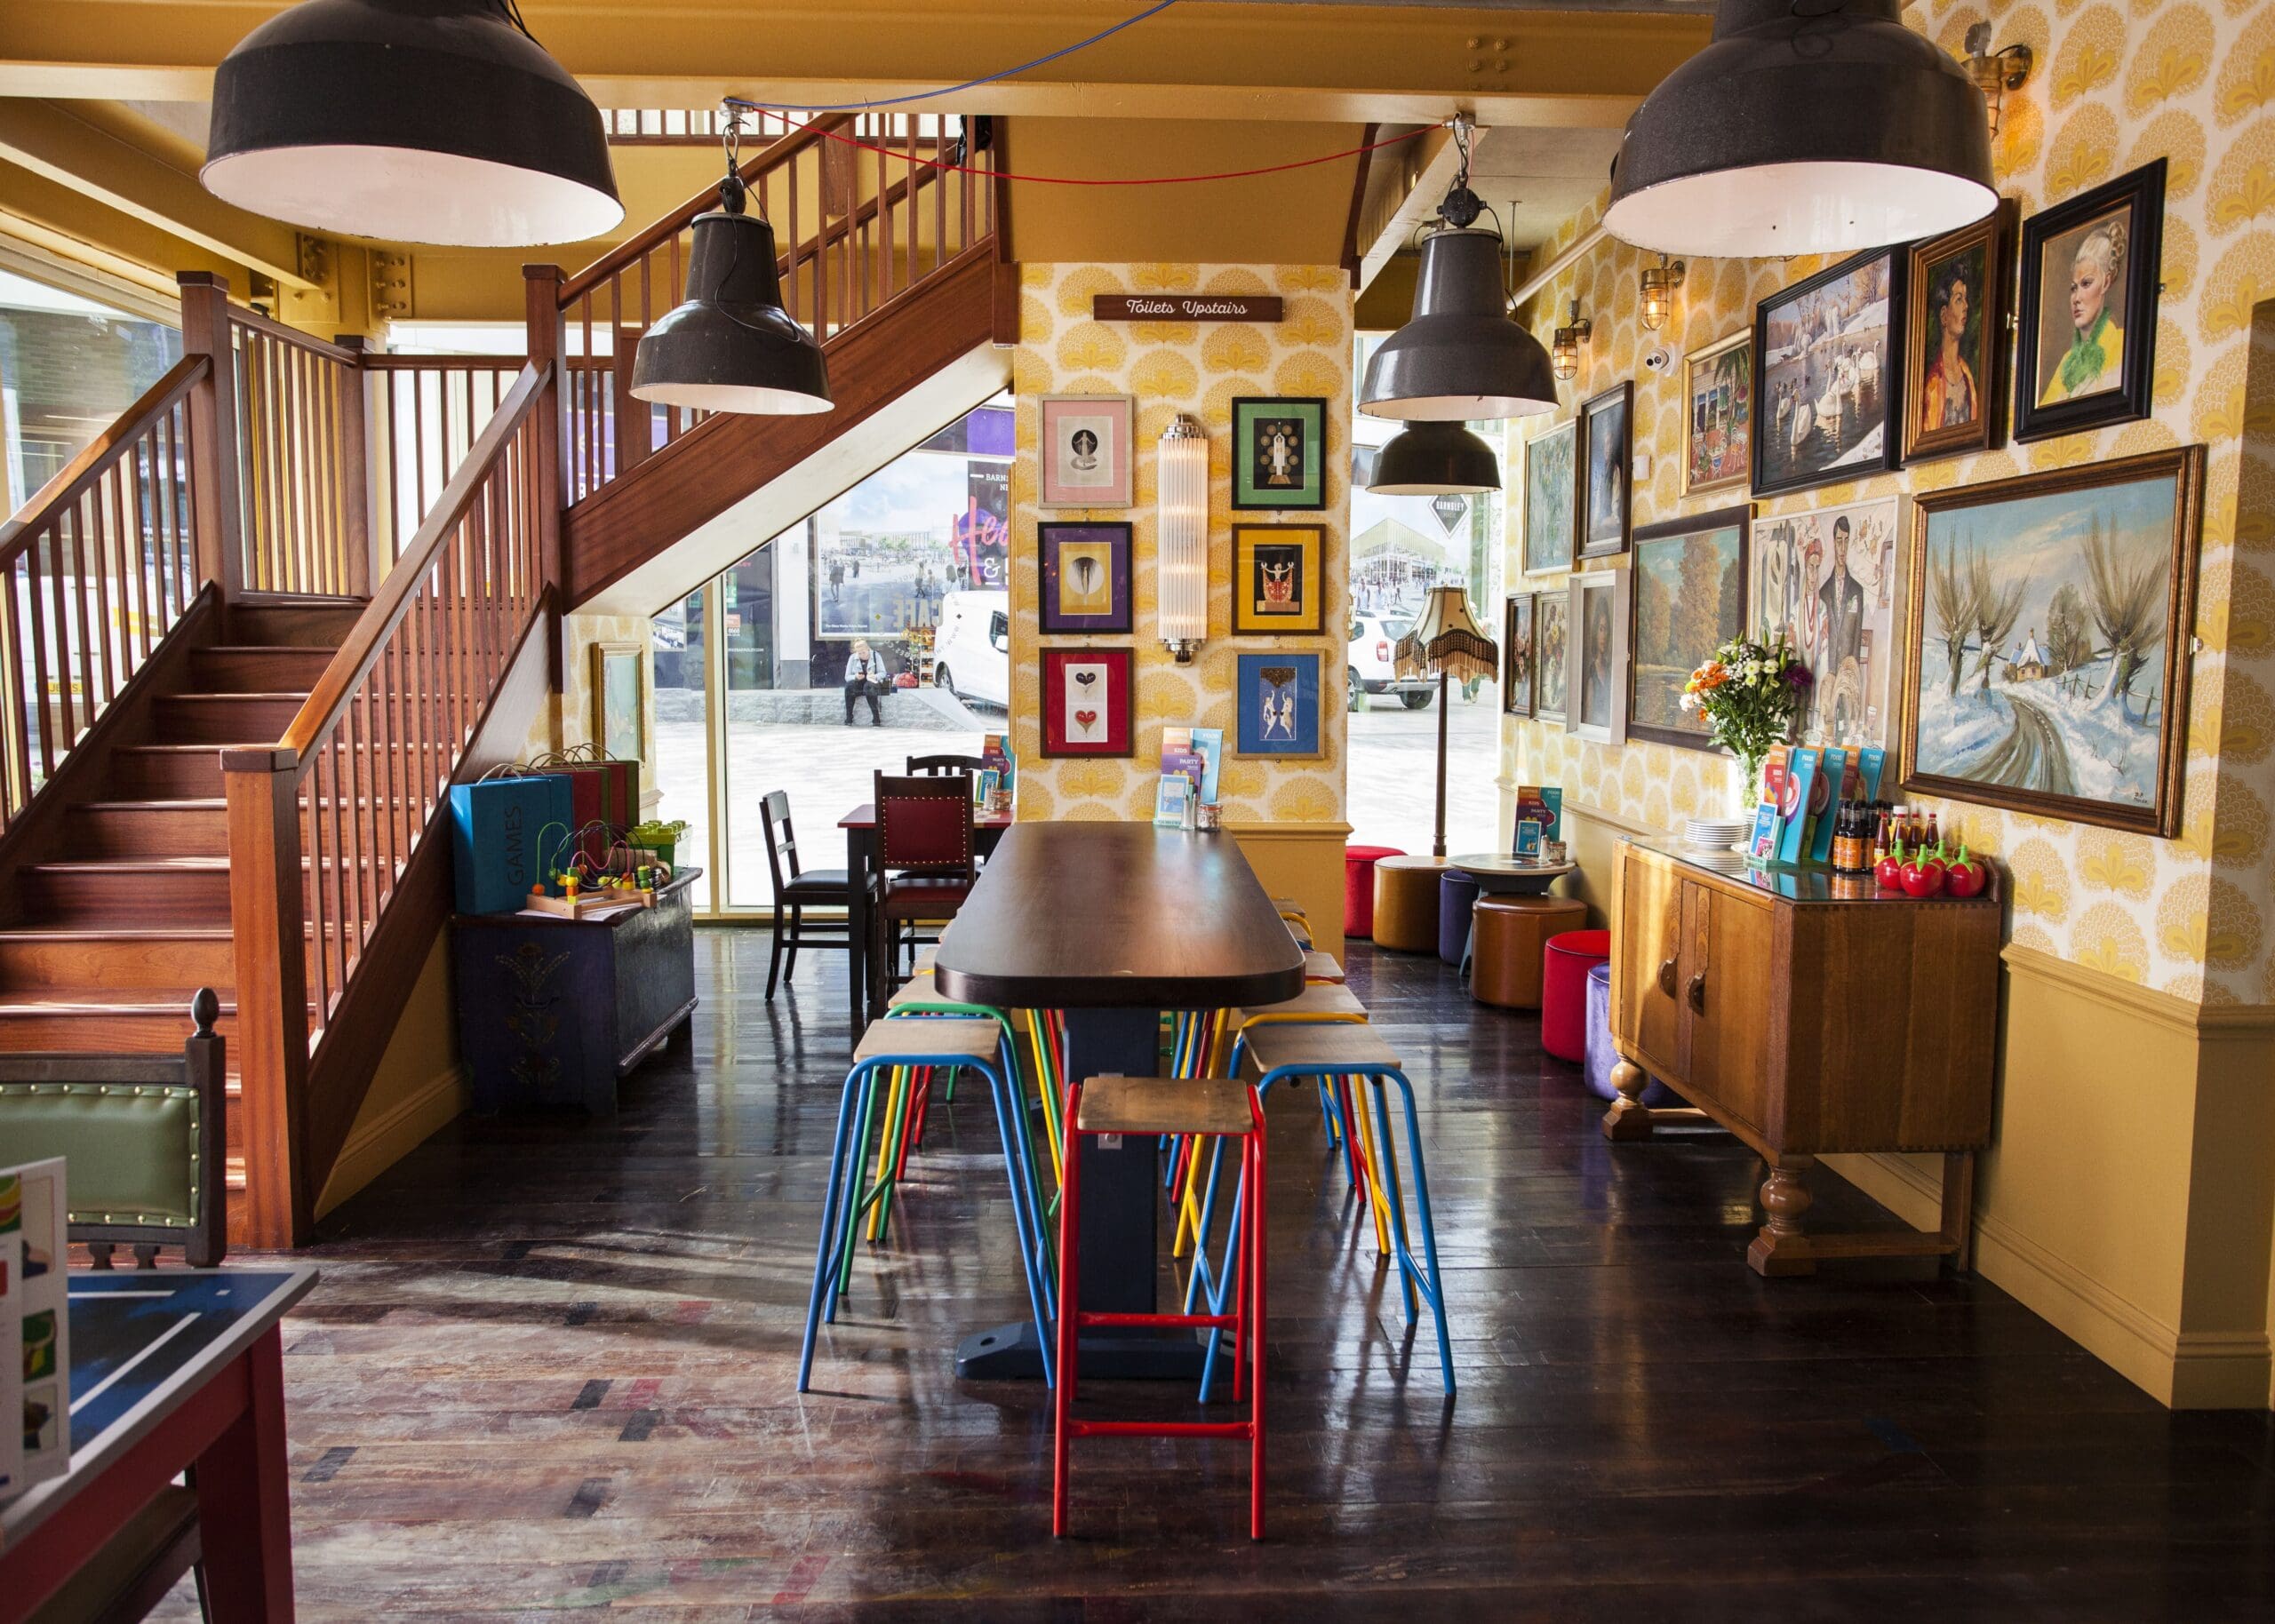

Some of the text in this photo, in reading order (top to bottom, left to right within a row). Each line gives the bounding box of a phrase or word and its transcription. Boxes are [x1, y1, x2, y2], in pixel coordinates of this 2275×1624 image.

[1126, 299, 1248, 317] Toilets Upstairs
[986, 474, 1008, 482] BARN
[505, 805, 524, 886] GAMES
